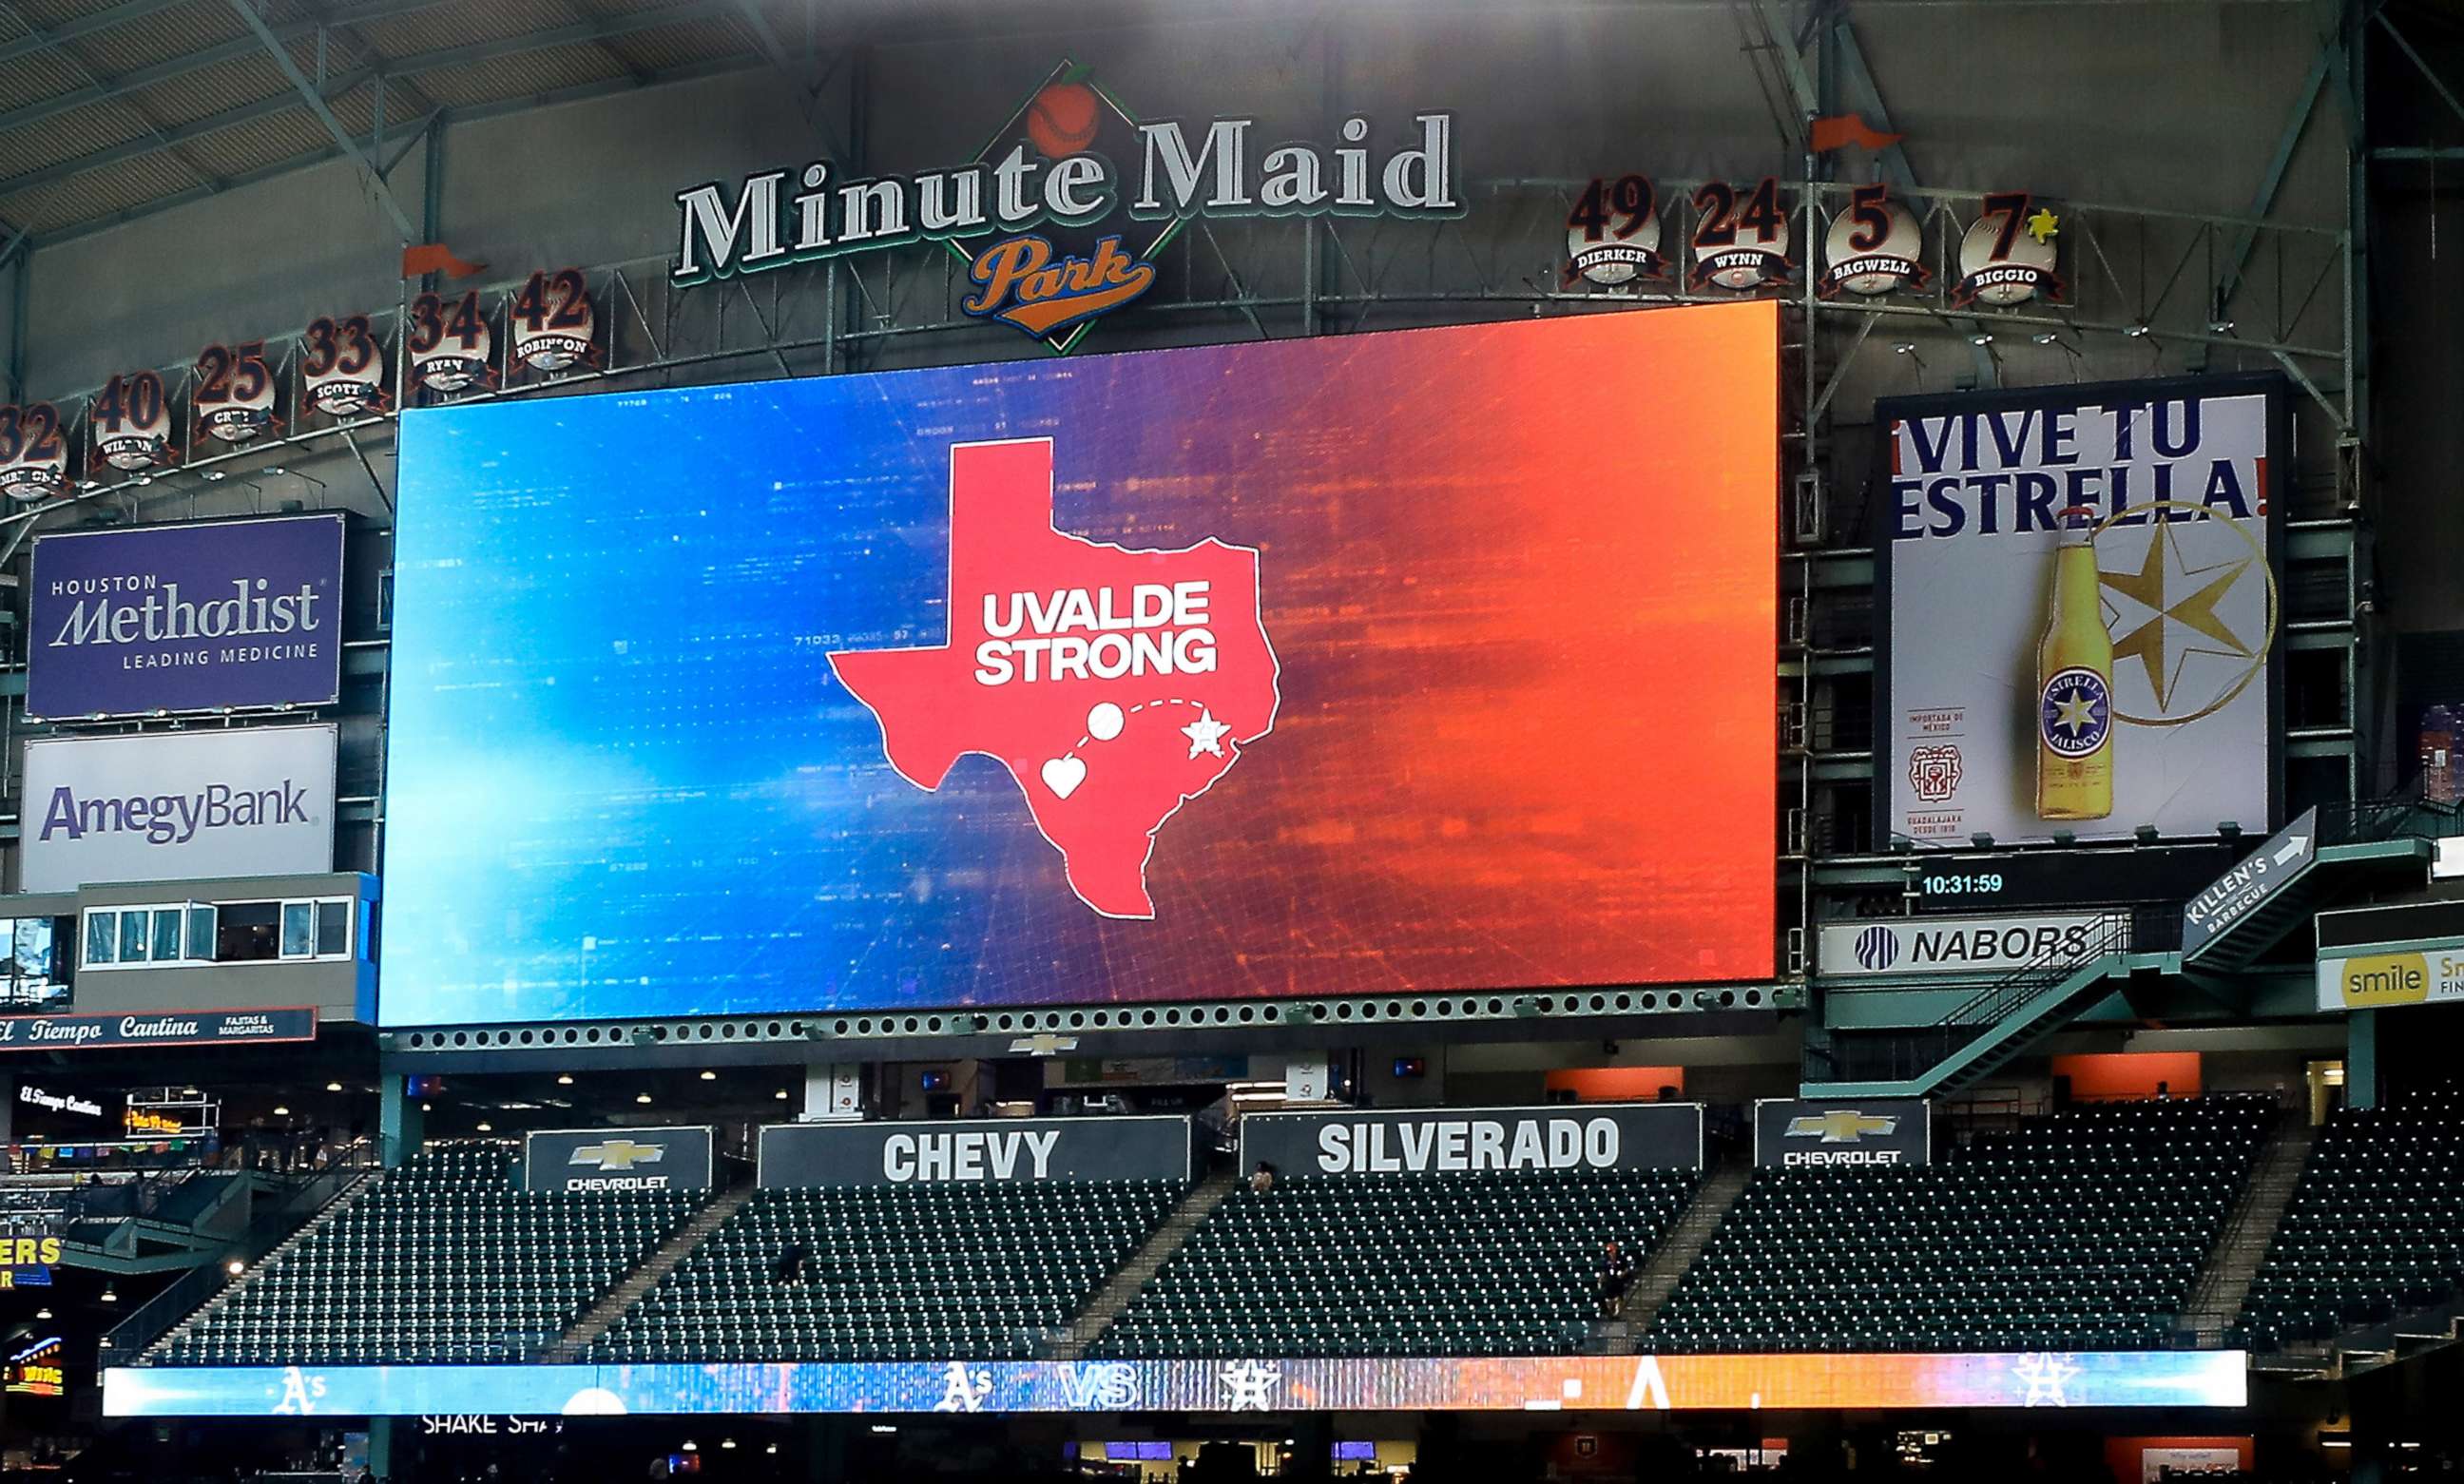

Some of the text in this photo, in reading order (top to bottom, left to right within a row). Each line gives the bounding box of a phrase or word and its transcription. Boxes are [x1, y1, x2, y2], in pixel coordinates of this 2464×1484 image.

[674, 112, 1458, 278] Minute Maid
[1567, 174, 1654, 243] 49
[1692, 175, 1783, 248] 24
[1848, 182, 1894, 253] 5
[1982, 192, 2031, 262] 7
[964, 235, 1153, 318] Park
[1577, 248, 1647, 269] DIERKER
[1713, 253, 1764, 268] WYNN
[1833, 259, 1911, 280] BAGWELL
[1974, 269, 2038, 286] BIGGIO
[408, 289, 485, 354] 34
[510, 267, 590, 332] 42
[194, 340, 268, 405] 25
[303, 315, 374, 377] 33
[90, 370, 165, 434] 40
[213, 410, 250, 424] CR
[102, 438, 153, 455] WILON
[2102, 397, 2203, 462] TU
[51, 574, 158, 596] HOUSTON
[982, 580, 1211, 638] UVALDE
[48, 577, 320, 648] Methodist
[123, 643, 318, 670] LEADING MEDICINE
[973, 627, 1219, 687] STRONG
[2046, 675, 2105, 703] ESTRELLA
[2050, 730, 2101, 750] JALISCO
[39, 778, 309, 845] AmegyBank
[1922, 874, 2003, 896] 10:31:59
[2185, 858, 2268, 926] KILLEN'S
[2205, 882, 2268, 935] BARBECUE
[1911, 925, 2088, 963] NABORS
[2349, 965, 2421, 993] smile
[28, 1017, 104, 1045] Tiempo
[119, 1015, 199, 1038] Cantina
[218, 1025, 275, 1035] MARGARITAS
[882, 1129, 1061, 1183] CHEVY
[1316, 1116, 1620, 1173] SILVERADO
[1782, 1148, 1902, 1166] CHEVROLET
[567, 1175, 669, 1192] CHEVROLET
[933, 1360, 993, 1413] A's
[1057, 1362, 1138, 1409] VS
[421, 1414, 497, 1435] SHAKE
